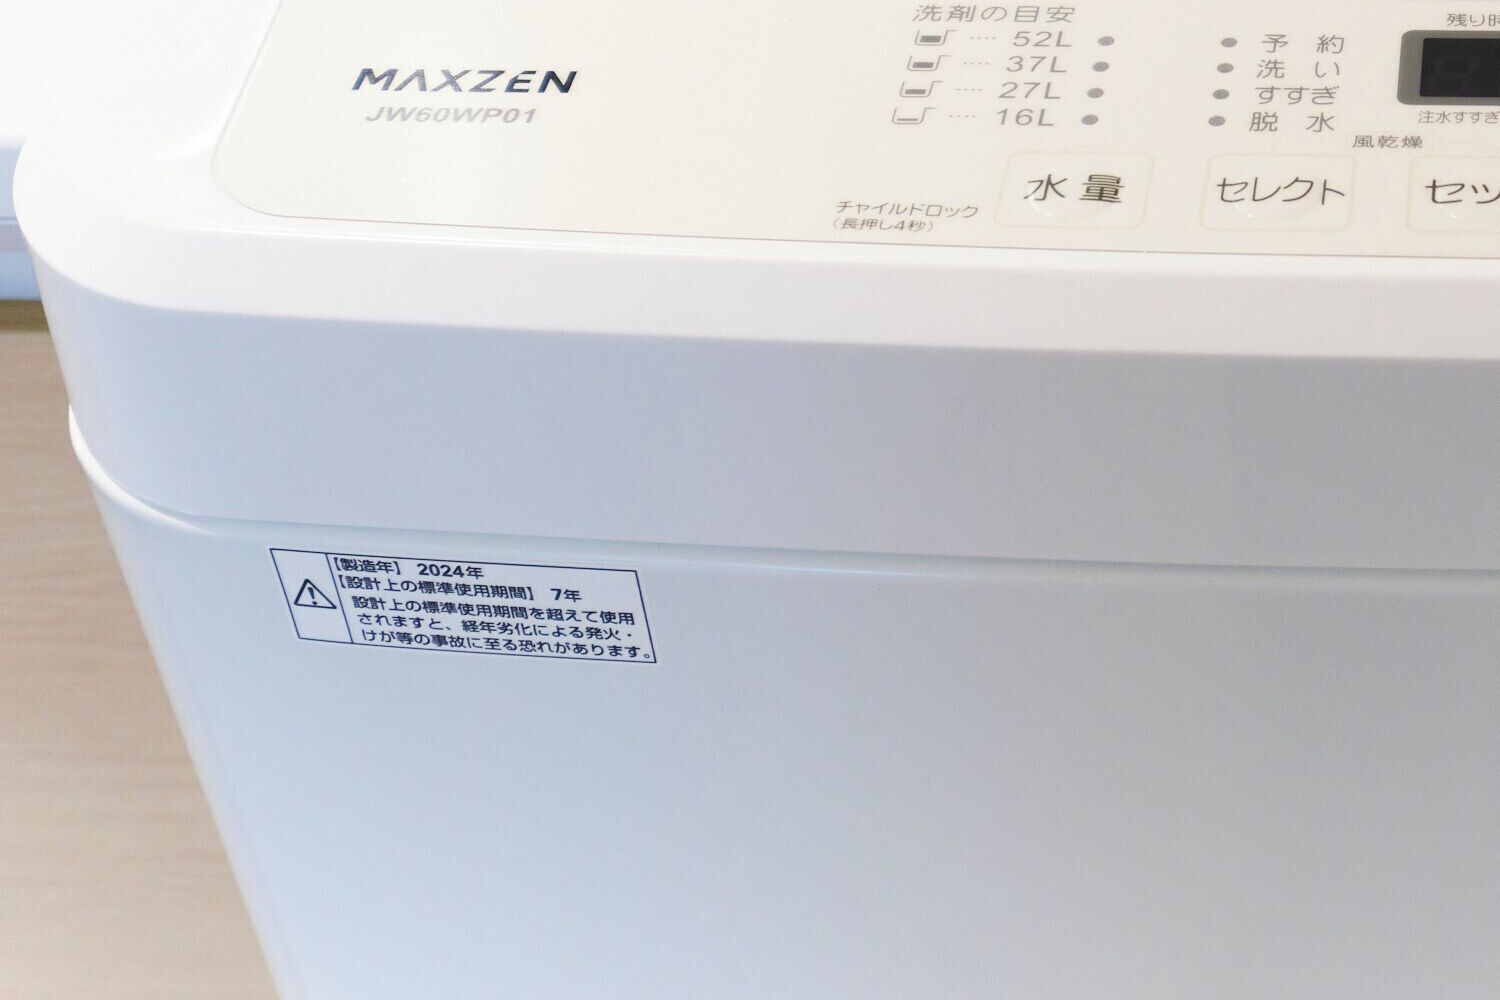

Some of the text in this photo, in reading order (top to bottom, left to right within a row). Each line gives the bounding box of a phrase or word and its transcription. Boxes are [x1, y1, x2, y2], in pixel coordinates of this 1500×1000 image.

[912, 4, 1076, 24] 洗剤の目安
[1012, 30, 1073, 48] 52L
[1261, 33, 1345, 55] 予約
[1005, 55, 1067, 74] 37L
[1256, 58, 1340, 79] 洗い
[351, 68, 578, 94] MAXZEN
[998, 81, 1061, 100] 27L
[1254, 85, 1340, 106] すすぎ
[364, 106, 537, 124] JW60WP01
[996, 108, 1055, 127] 16L
[1248, 111, 1335, 133] 脱水
[1418, 109, 1500, 125] 注水すすぎ
[1352, 134, 1423, 150] 風乾燥
[1023, 173, 1125, 204] 水量
[1216, 176, 1346, 206] セレクト
[835, 200, 979, 221] チャイルドロック
[332, 556, 485, 580] 【製造年】 2024年
[549, 586, 583, 602] 7年
[351, 595, 636, 627] 設計上の標準使用期間を超えて使用
[357, 612, 633, 642] されますと、経年劣化による発火・
[361, 628, 651, 660] けが等の事故に至る恐れがあります。
